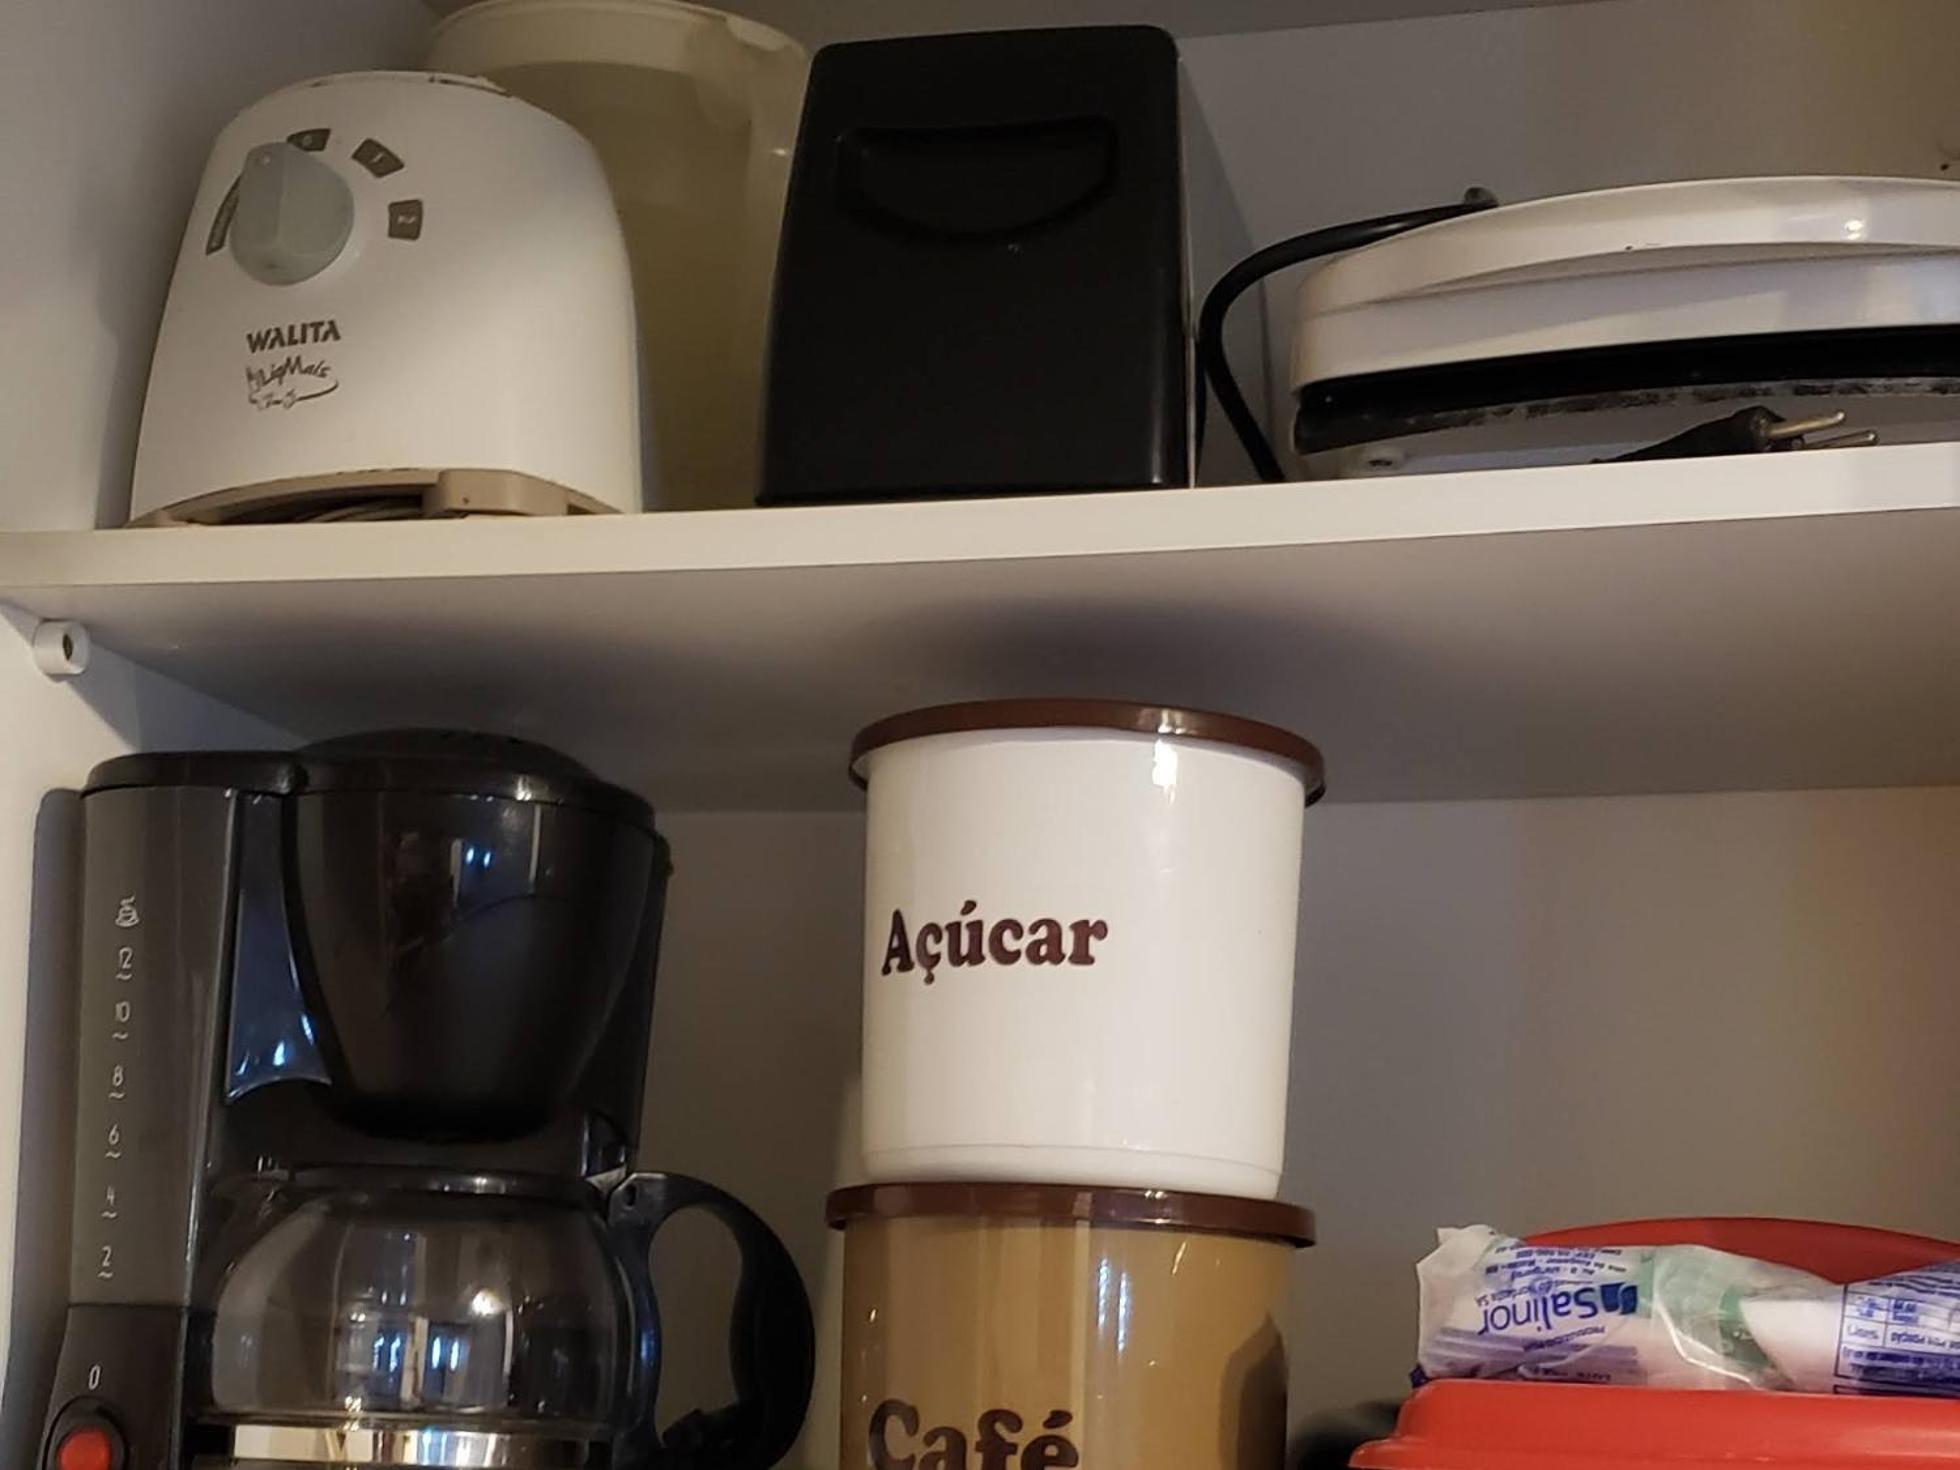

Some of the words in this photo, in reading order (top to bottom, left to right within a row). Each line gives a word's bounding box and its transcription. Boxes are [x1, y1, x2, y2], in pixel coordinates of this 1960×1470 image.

[246, 320, 341, 353] WALITA
[881, 900, 1109, 985] Açúcar
[119, 947, 133, 969] 12
[115, 1001, 131, 1022] 10
[112, 1065, 124, 1086] 8
[108, 1124, 120, 1145] 6
[106, 1185, 115, 1206] 4
[101, 1245, 112, 1267] 2
[1478, 1286, 1598, 1335] Salinor
[88, 1364, 101, 1390] 0
[869, 1398, 1079, 1470] Café
